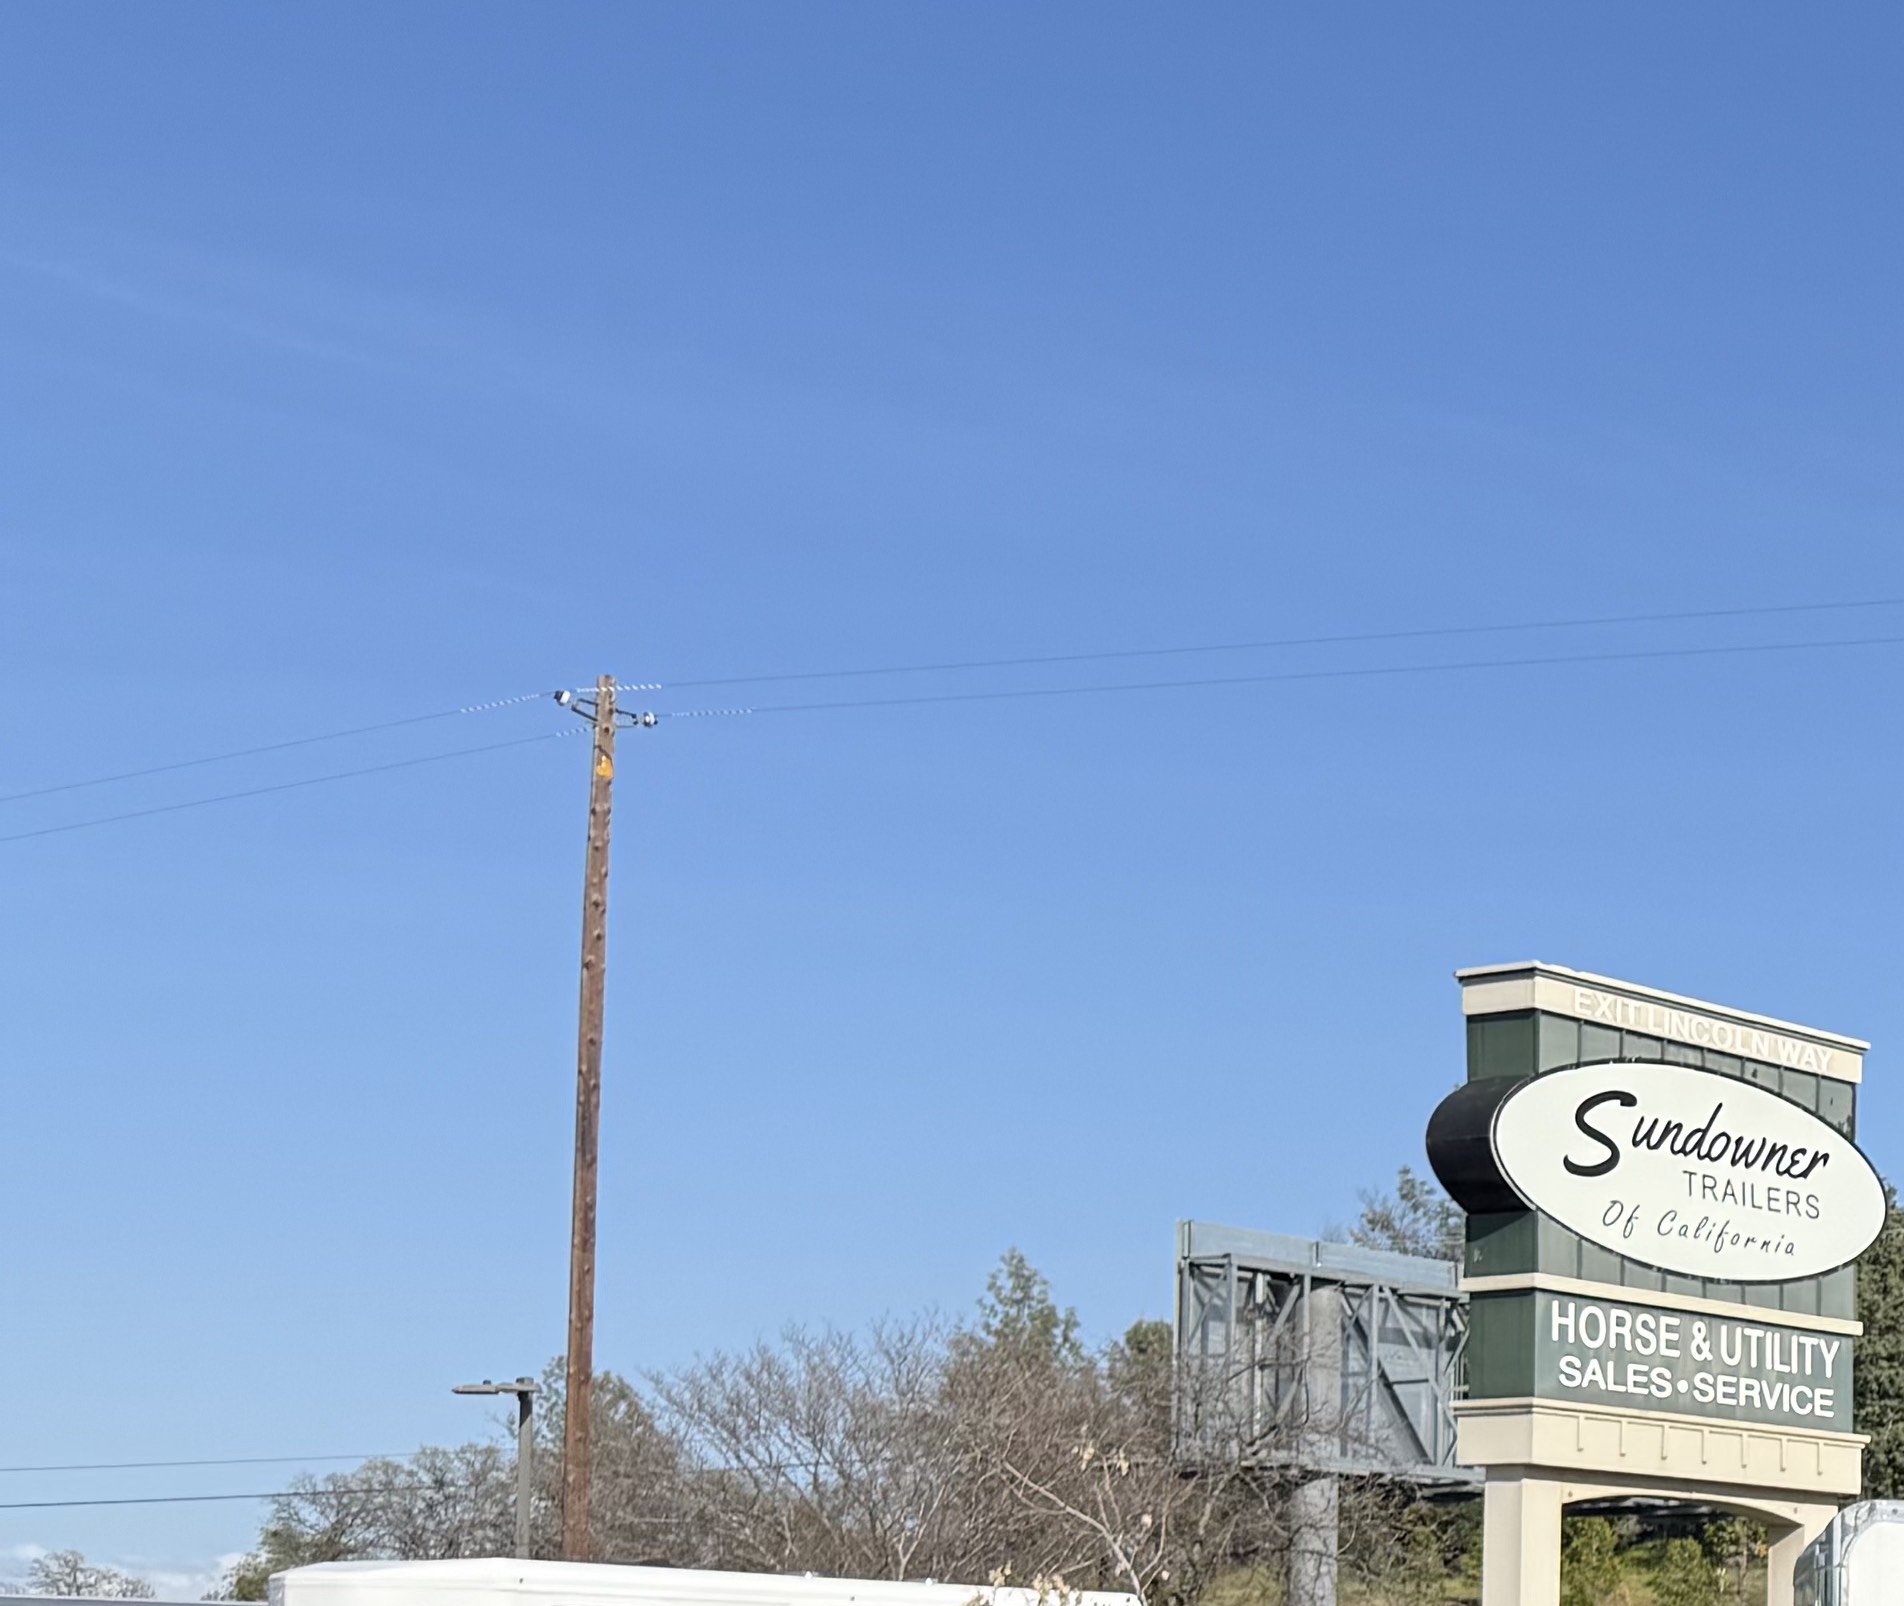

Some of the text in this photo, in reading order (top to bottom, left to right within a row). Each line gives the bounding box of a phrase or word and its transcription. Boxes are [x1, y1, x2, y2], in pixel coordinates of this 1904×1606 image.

[1574, 988, 1833, 1072] EXIT LINCOLN WAY
[1563, 1090, 1830, 1179] Sundowner
[1602, 1200, 1795, 1256] Of California
[1683, 1170, 1820, 1219] TRAILERS
[1551, 1300, 1840, 1379] HORSE & UTILITY
